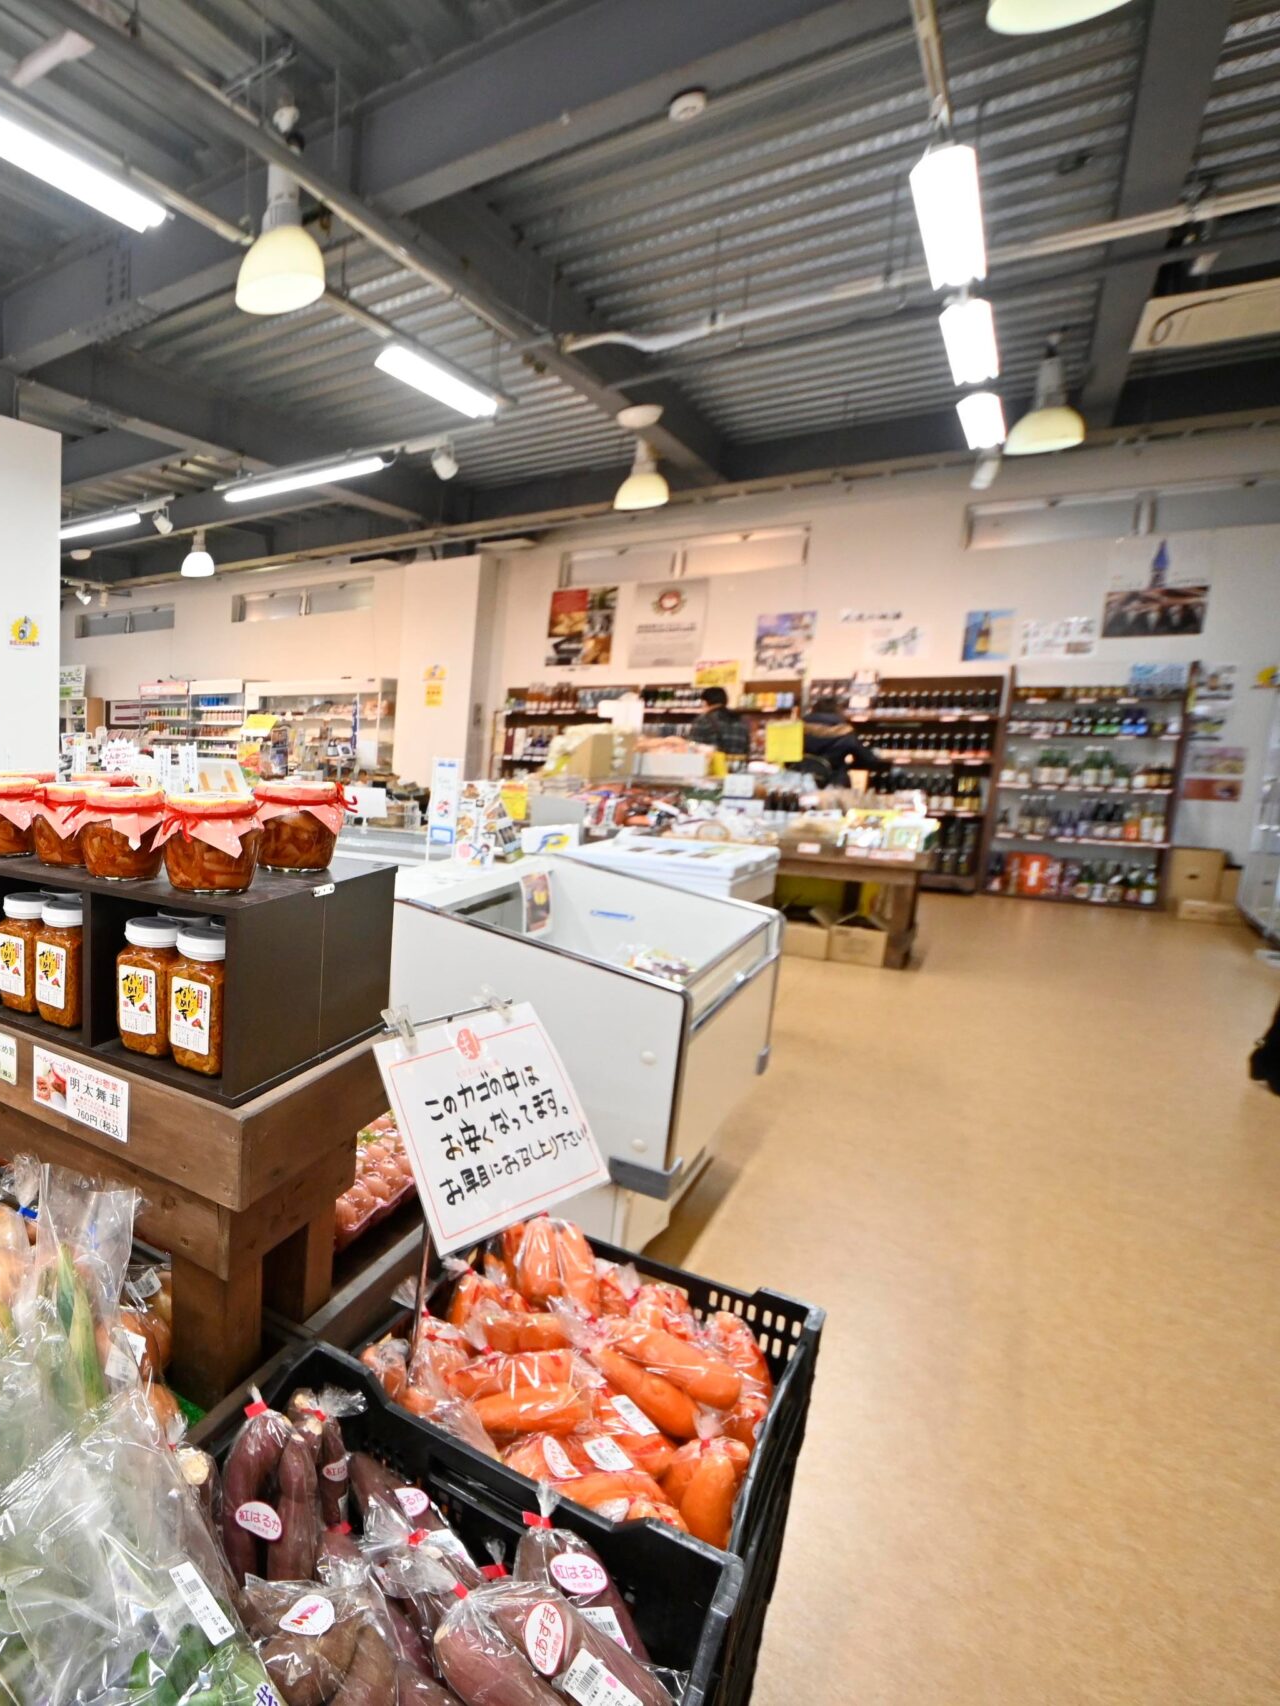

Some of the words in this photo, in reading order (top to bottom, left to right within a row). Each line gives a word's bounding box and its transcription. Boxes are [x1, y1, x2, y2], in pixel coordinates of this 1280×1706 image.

[424, 1065, 541, 1121] このカゴの中は
[440, 1088, 570, 1161] お安くなってます。
[238, 1509, 280, 1532] 紅はるか
[553, 1564, 604, 1581] 紅はるか
